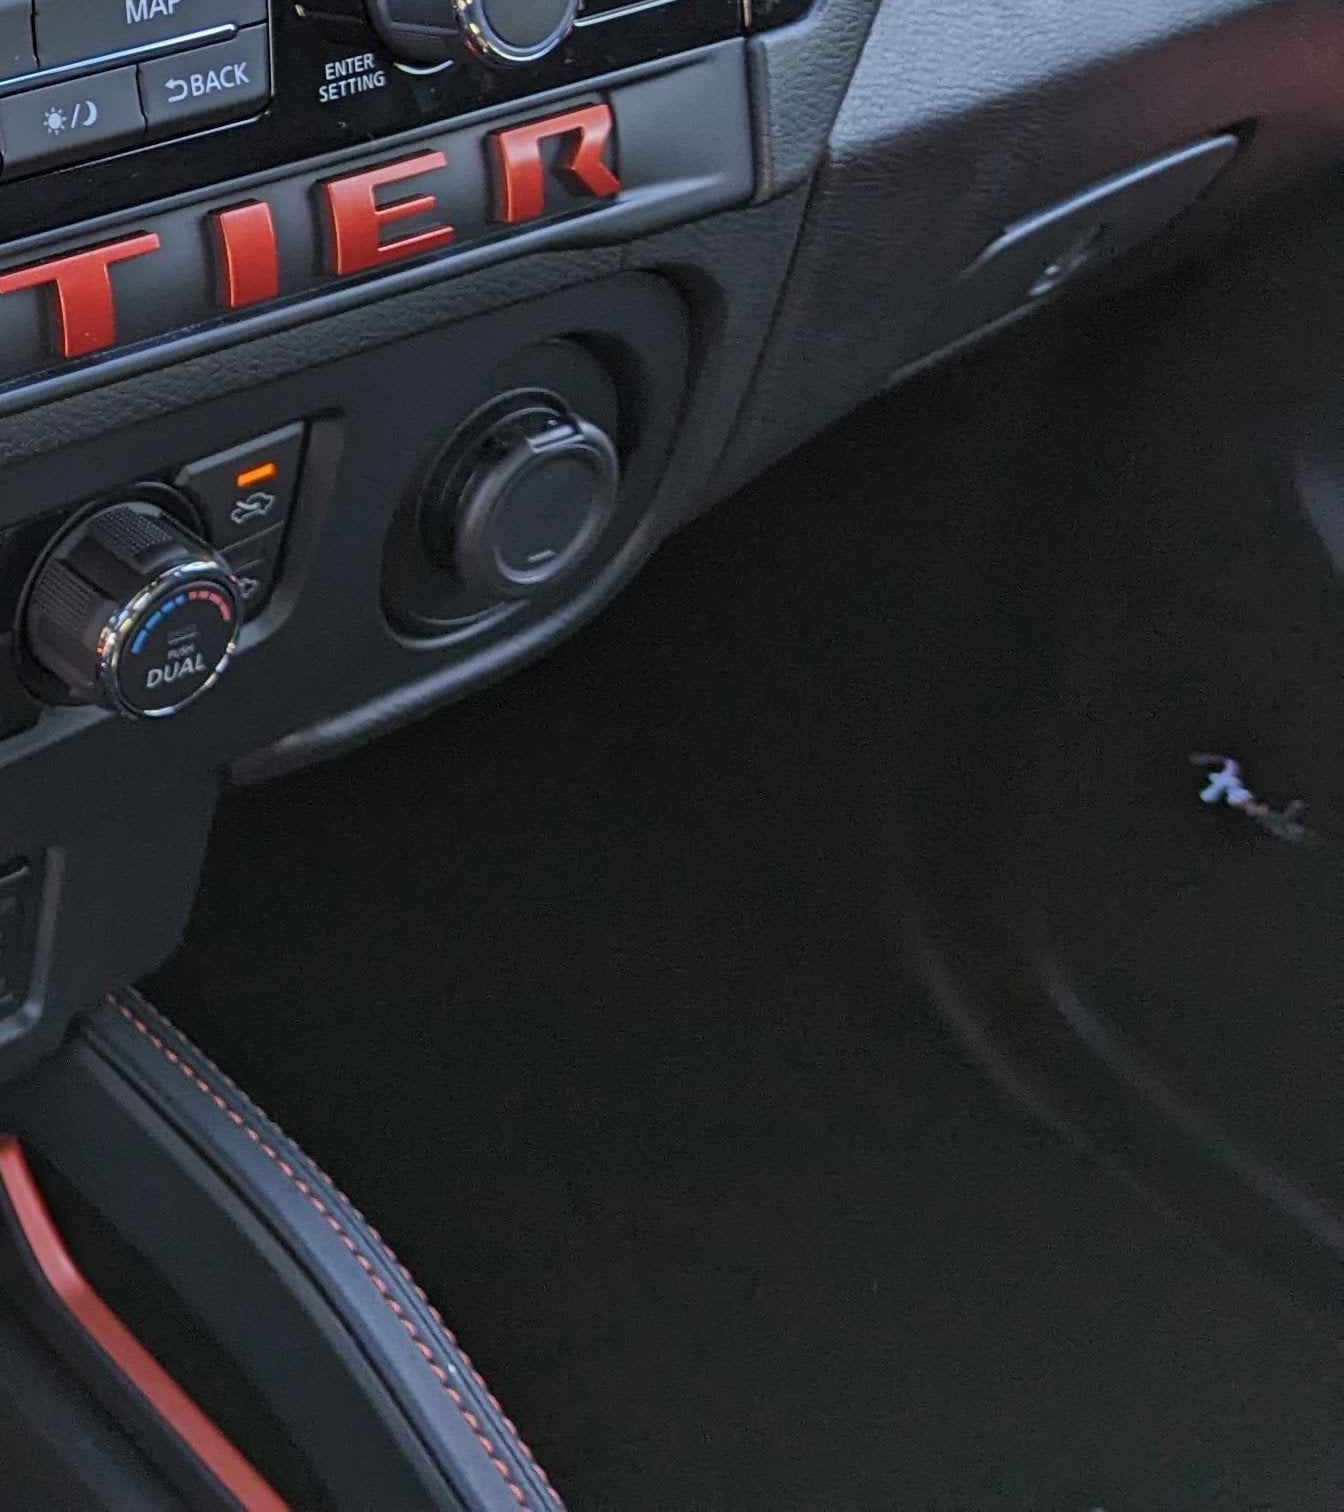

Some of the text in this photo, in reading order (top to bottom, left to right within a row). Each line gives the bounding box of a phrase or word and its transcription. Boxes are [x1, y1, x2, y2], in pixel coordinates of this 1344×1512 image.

[190, 62, 250, 98] BACK
[324, 53, 376, 80] ENTER
[318, 70, 387, 104] SETTING
[146, 653, 206, 688] DUAL
